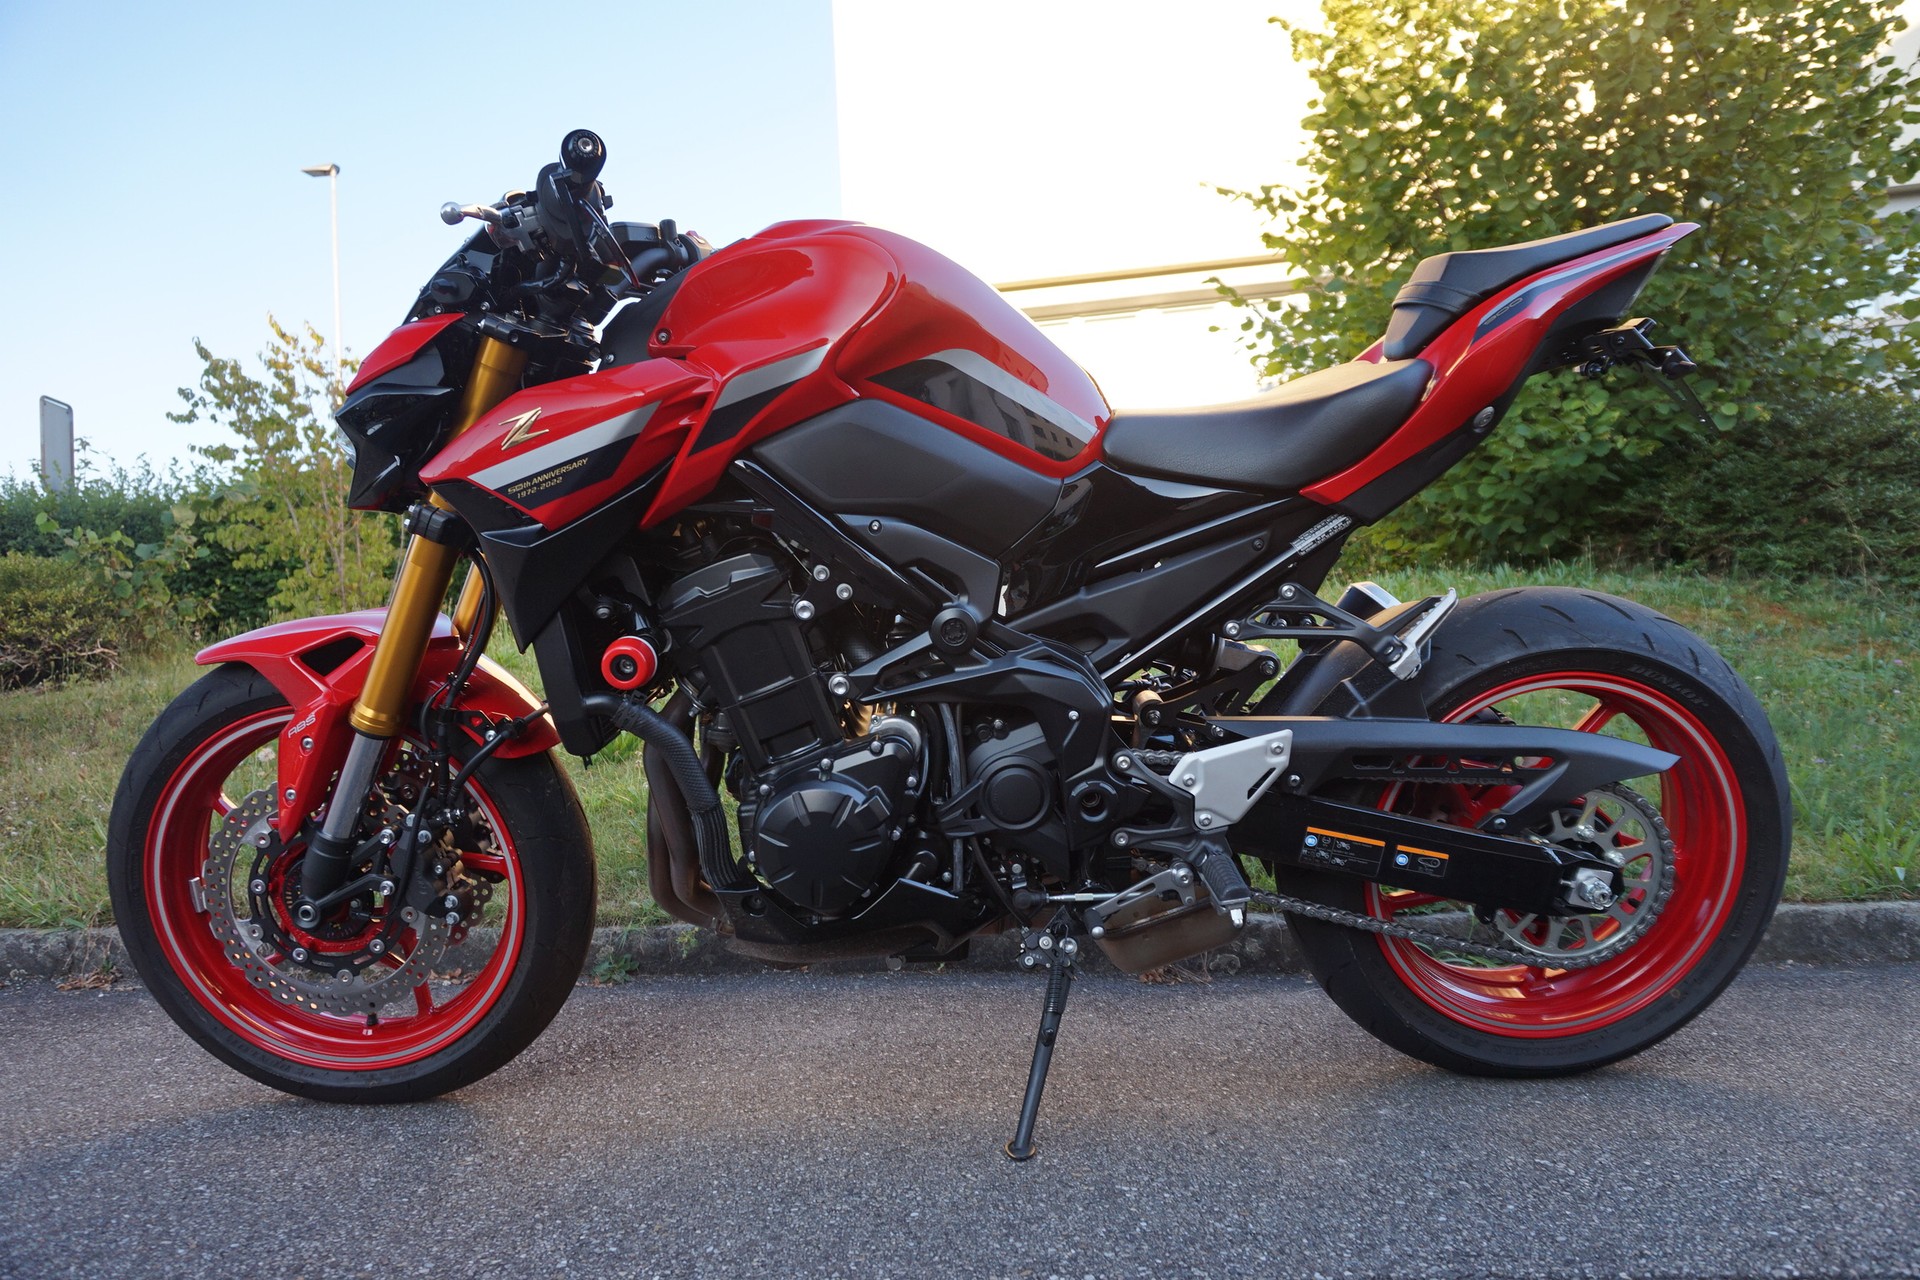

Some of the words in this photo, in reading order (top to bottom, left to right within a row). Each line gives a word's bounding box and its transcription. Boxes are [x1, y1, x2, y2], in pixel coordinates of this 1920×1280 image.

[498, 406, 550, 451] Z
[507, 480, 531, 495] 50th
[532, 457, 589, 485] ANNIVERSARY
[288, 714, 317, 739] ABS
